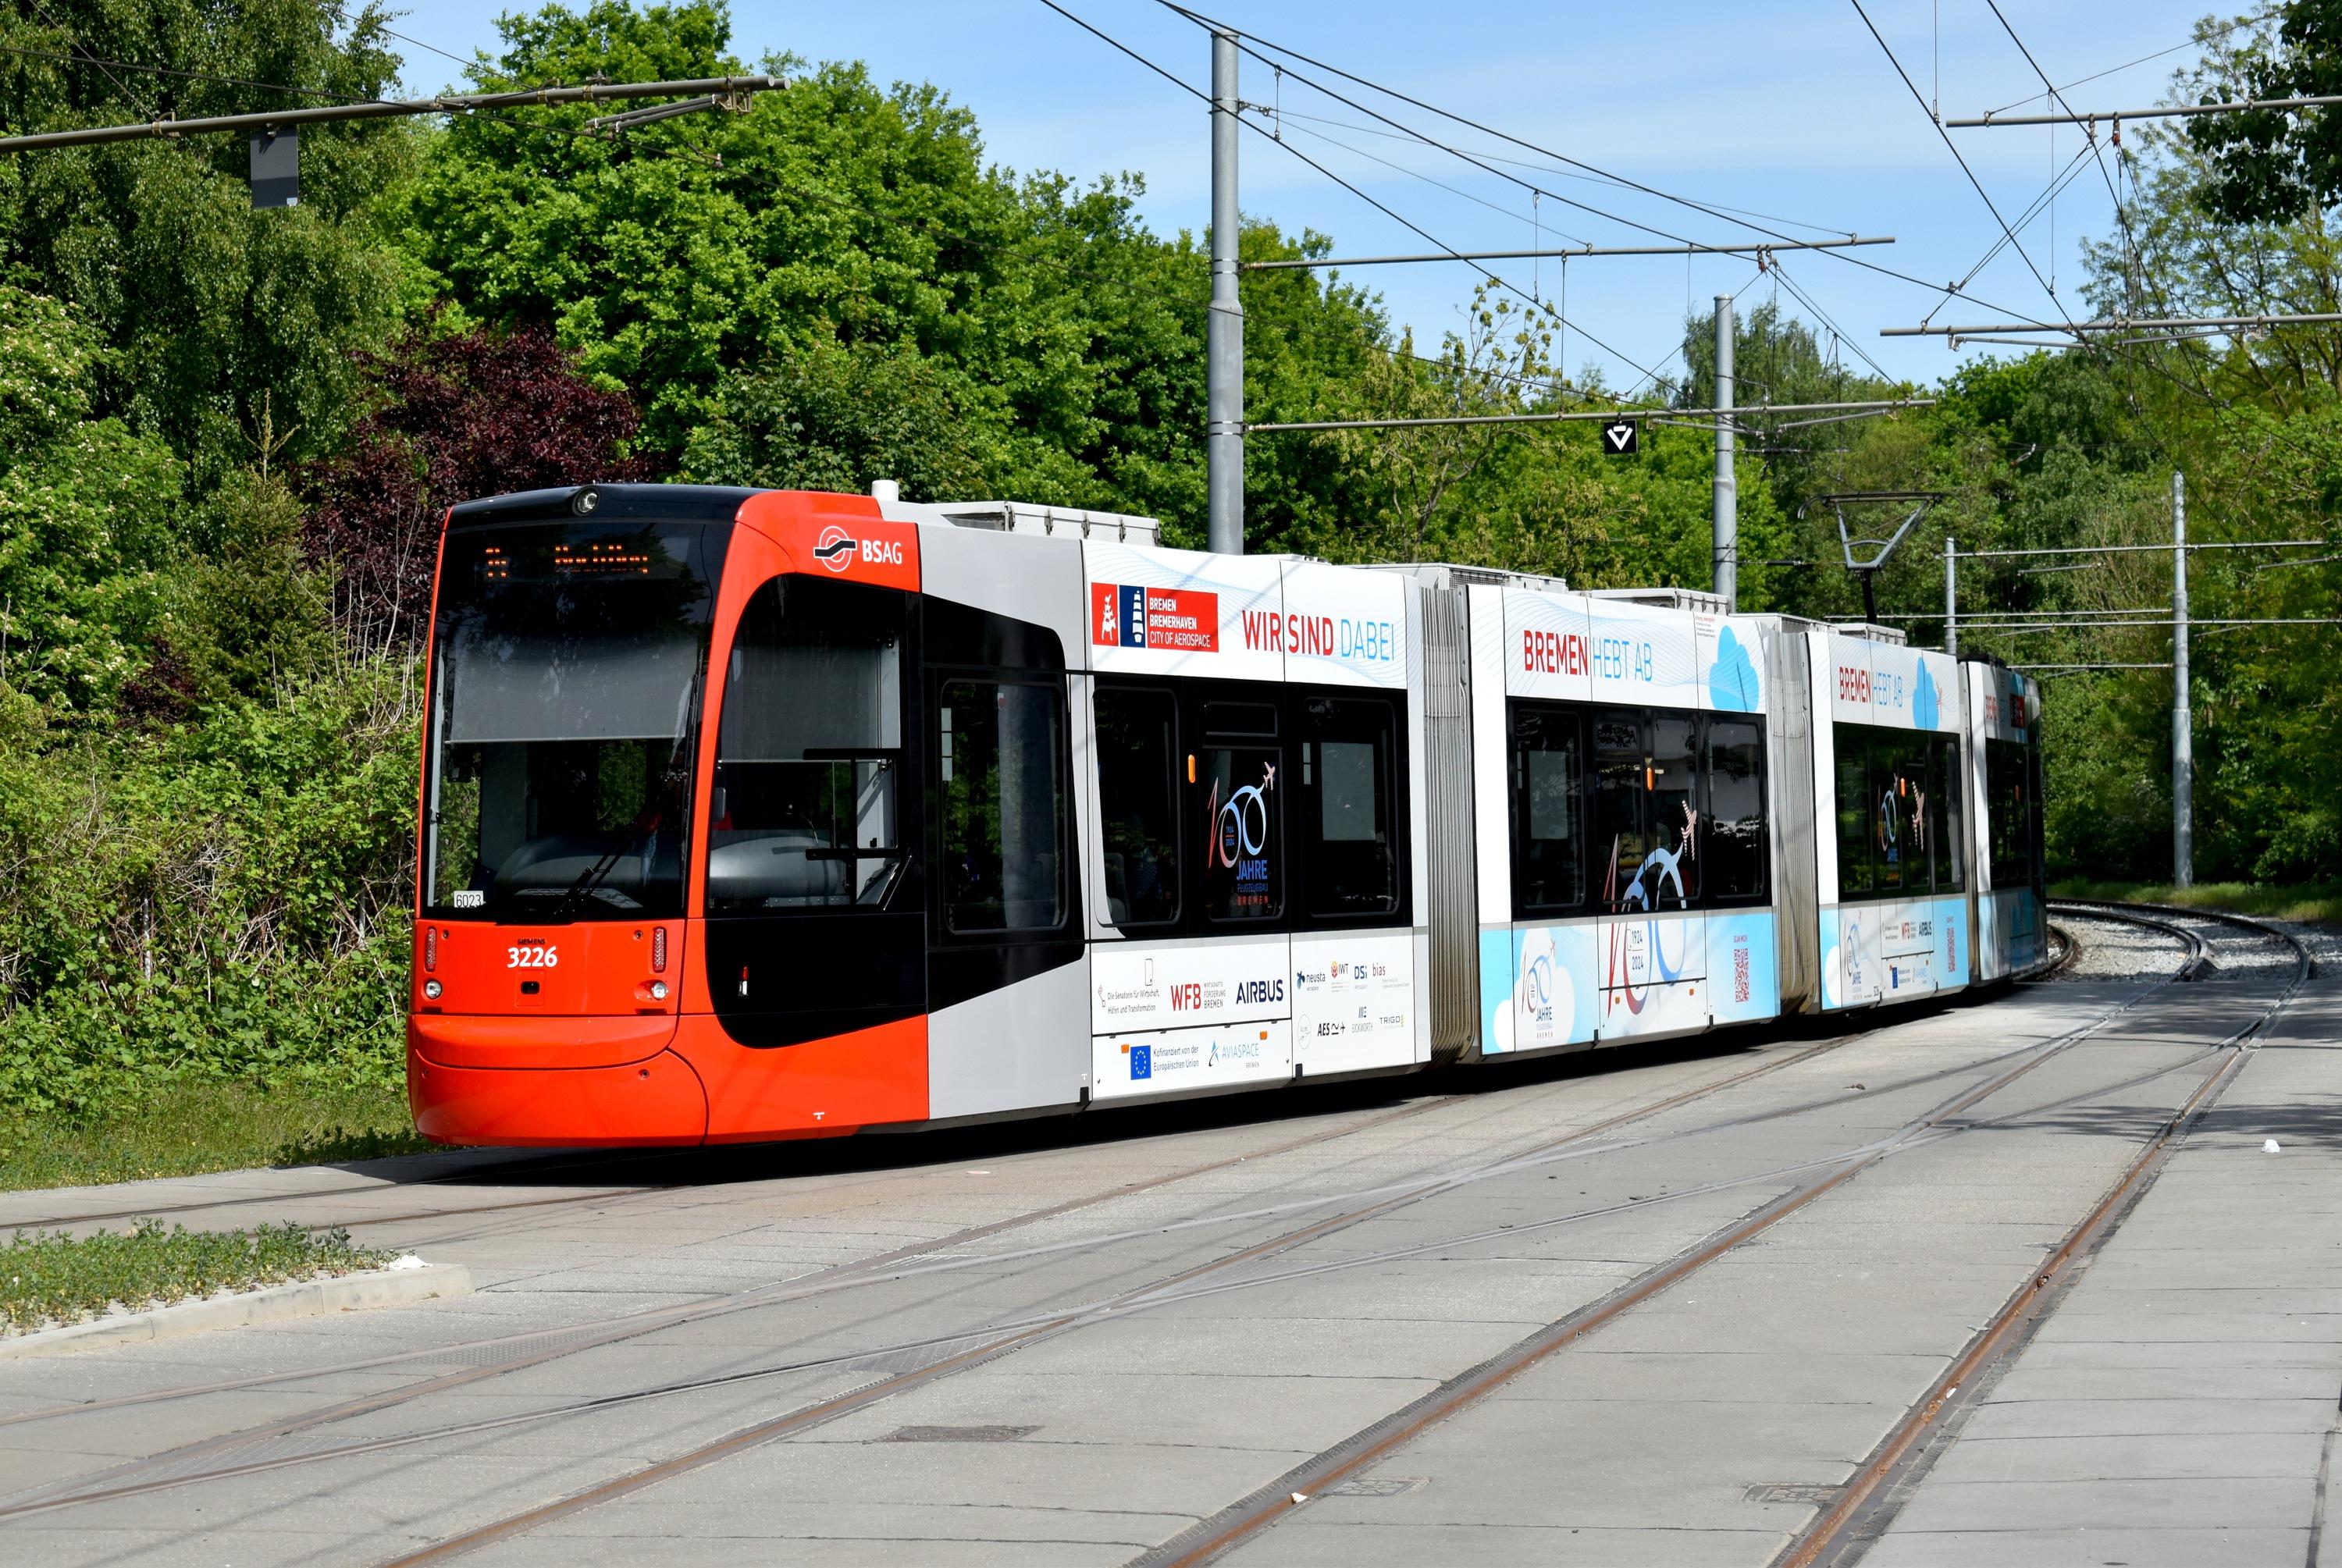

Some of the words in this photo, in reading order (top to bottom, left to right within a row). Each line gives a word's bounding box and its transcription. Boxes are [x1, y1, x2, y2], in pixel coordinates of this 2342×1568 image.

[862, 539, 902, 564] BSAG
[1149, 597, 1176, 612] BREMEN
[1150, 614, 1197, 630] BREMERHAVEN
[1150, 631, 1163, 644] CITY
[1165, 632, 1173, 645] OF
[1174, 632, 1211, 647] AEROSPACE
[1242, 610, 1283, 652] WIR
[1288, 614, 1333, 656] SIND
[1341, 619, 1394, 661] DABEI
[1524, 630, 1588, 676] BREMEN
[1593, 637, 1630, 679] HEBT
[1635, 642, 1652, 681] AB
[1839, 667, 1871, 702] BREMEN
[1873, 672, 1891, 706] HEBT
[1894, 675, 1902, 707] AB
[1237, 859, 1268, 880] JAHRE
[456, 894, 481, 907] 6023
[1237, 895, 1269, 905] BREMEN
[1632, 930, 1643, 944] 1924
[507, 946, 557, 968] 3226
[1632, 956, 1643, 970] 2024
[1338, 963, 1348, 974] IWT
[1372, 962, 1386, 976] bias
[1306, 972, 1326, 983] neusta
[1171, 983, 1201, 1012] WFB
[1236, 979, 1283, 1004] AIRBUS
[1204, 999, 1223, 1009] BREMEN
[1536, 1007, 1552, 1022] JAHRE
[1318, 1022, 1329, 1036] AES
[1222, 1043, 1259, 1059] AVIASPACE
[1154, 1060, 1184, 1072] Europäischen
[1186, 1059, 1199, 1068] Union
